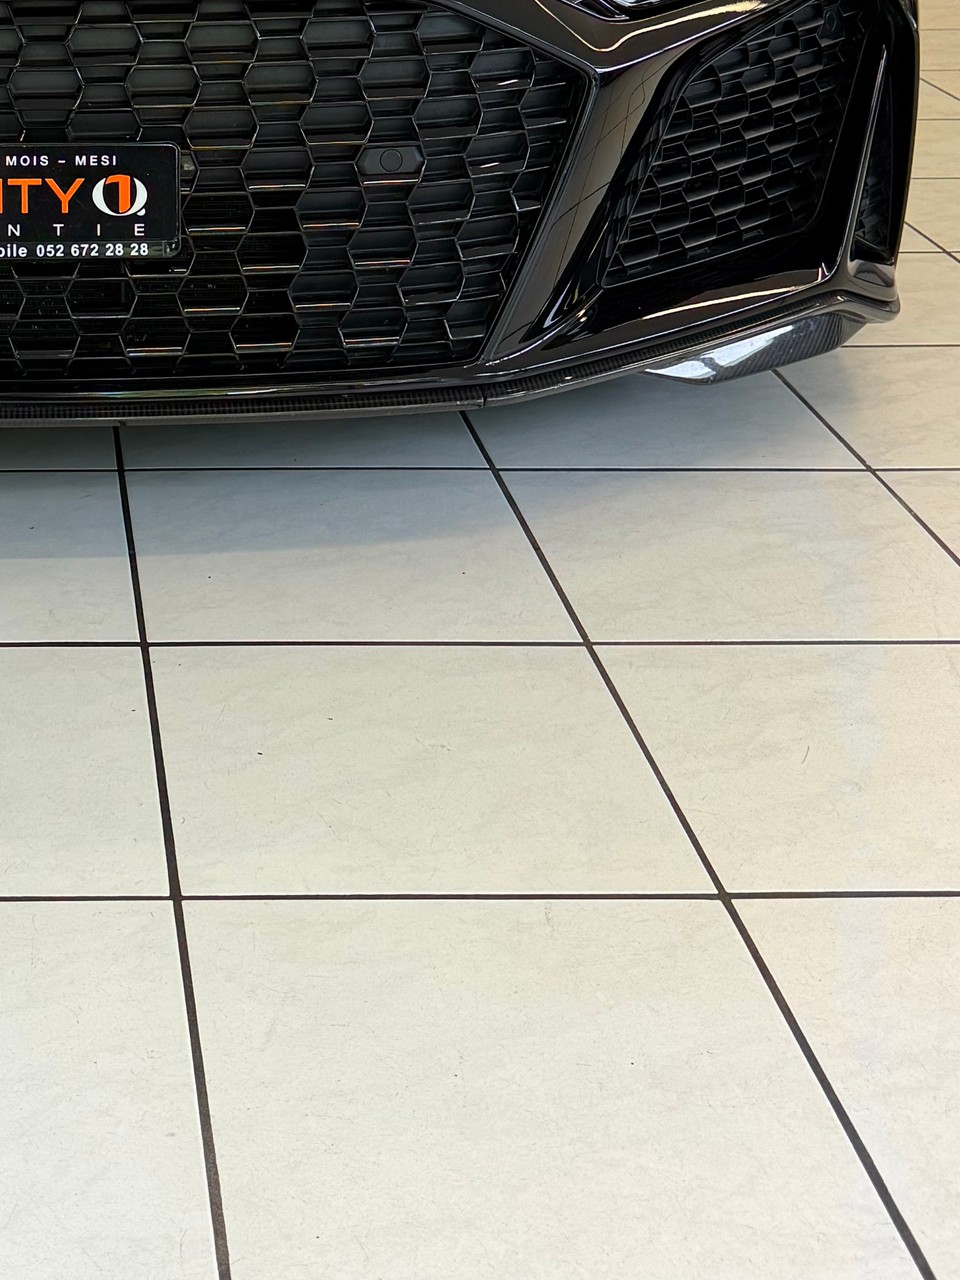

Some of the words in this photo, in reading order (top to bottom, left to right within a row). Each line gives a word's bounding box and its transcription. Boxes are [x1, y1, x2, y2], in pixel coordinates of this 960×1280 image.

[5, 154, 50, 167] MOIS
[74, 154, 118, 167] MESI
[36, 243, 65, 257] 052
[70, 243, 99, 257] 672
[105, 243, 124, 256] 28
[130, 242, 149, 256] 28
